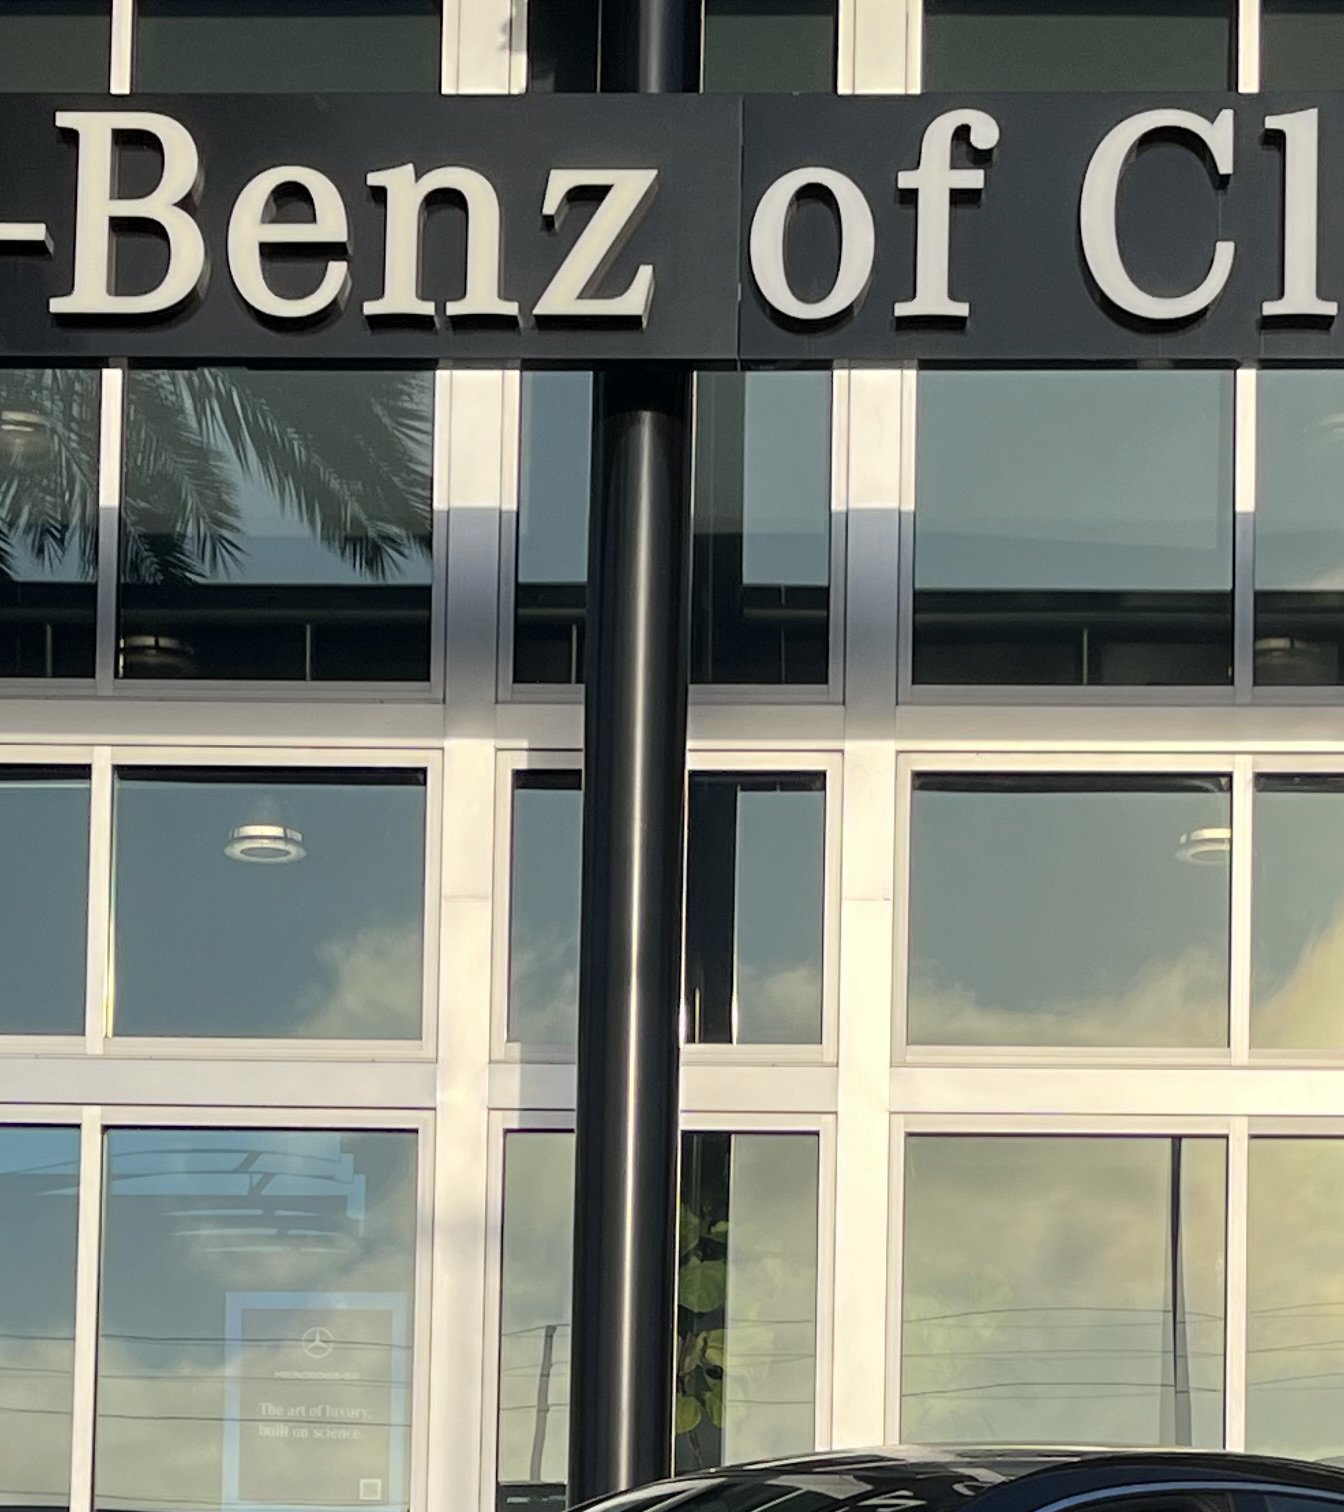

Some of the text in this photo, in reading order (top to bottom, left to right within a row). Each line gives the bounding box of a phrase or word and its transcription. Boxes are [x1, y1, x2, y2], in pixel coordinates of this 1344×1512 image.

[748, 106, 1002, 320] of
[259, 1401, 285, 1417] The
[287, 1405, 307, 1418] art
[308, 1404, 325, 1418] of
[258, 1423, 290, 1438] built
